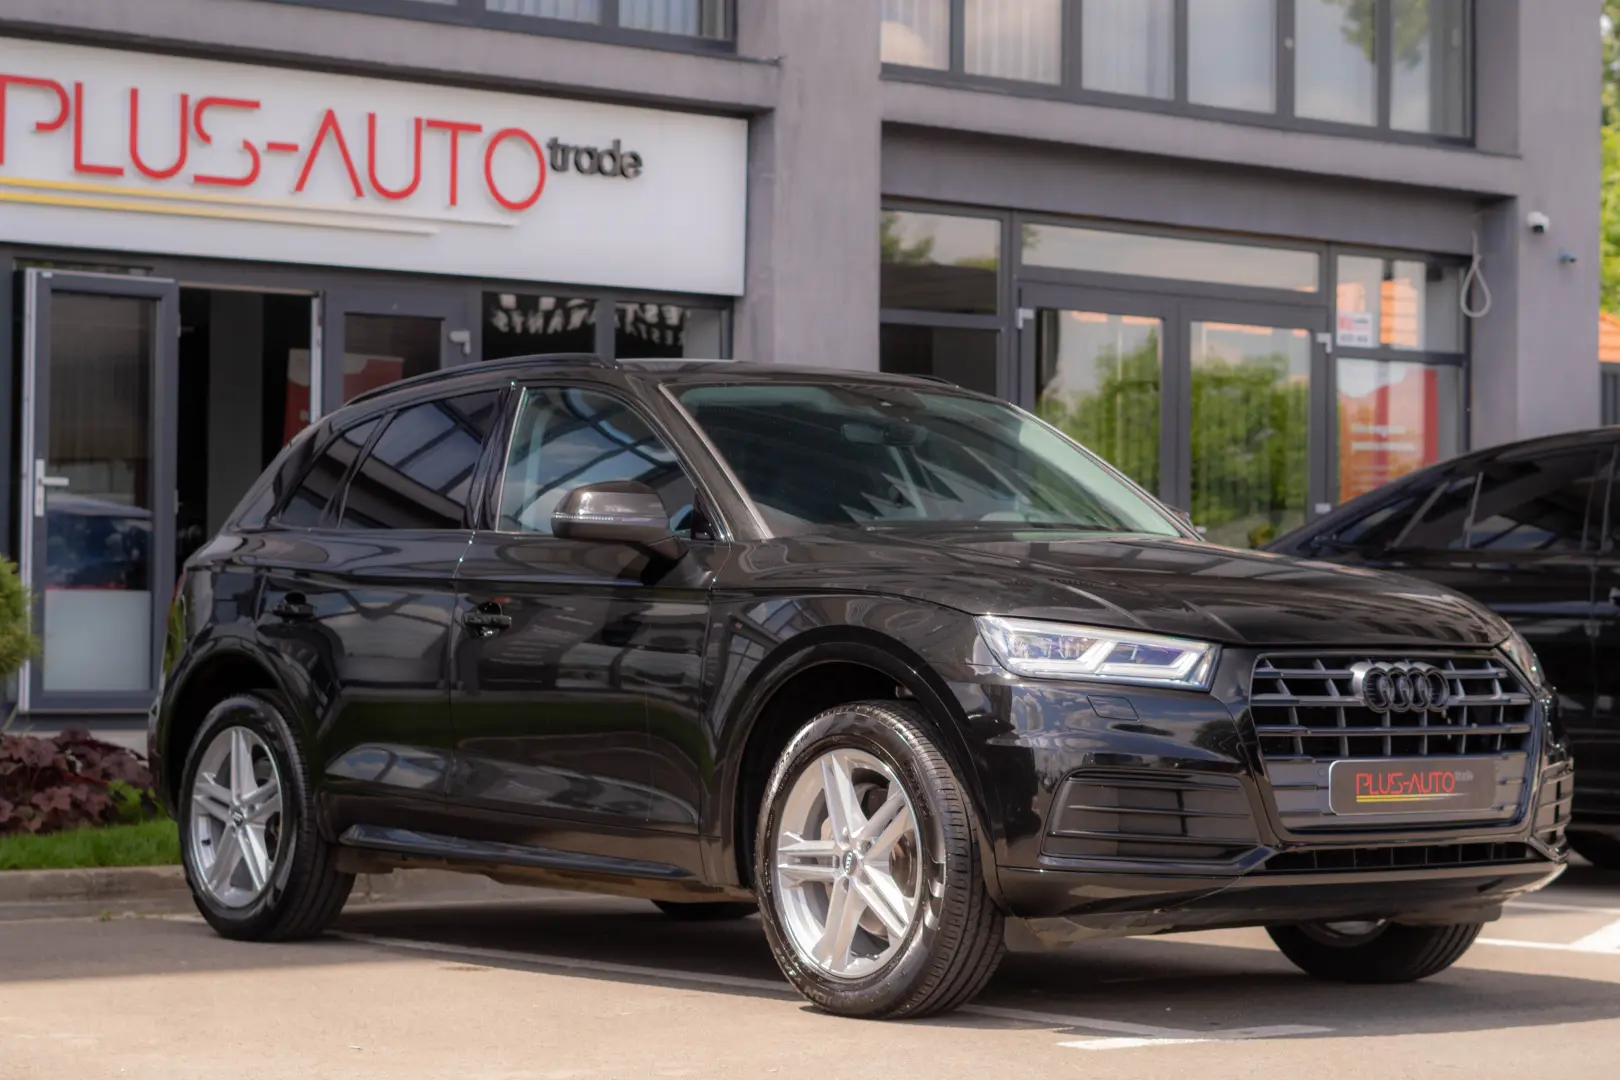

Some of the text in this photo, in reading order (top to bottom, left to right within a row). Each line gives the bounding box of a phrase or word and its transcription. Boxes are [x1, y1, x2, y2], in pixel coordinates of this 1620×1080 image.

[0, 73, 643, 211] PLUS-AUTO trade
[1355, 771, 1455, 795] PLUS-AUTO
